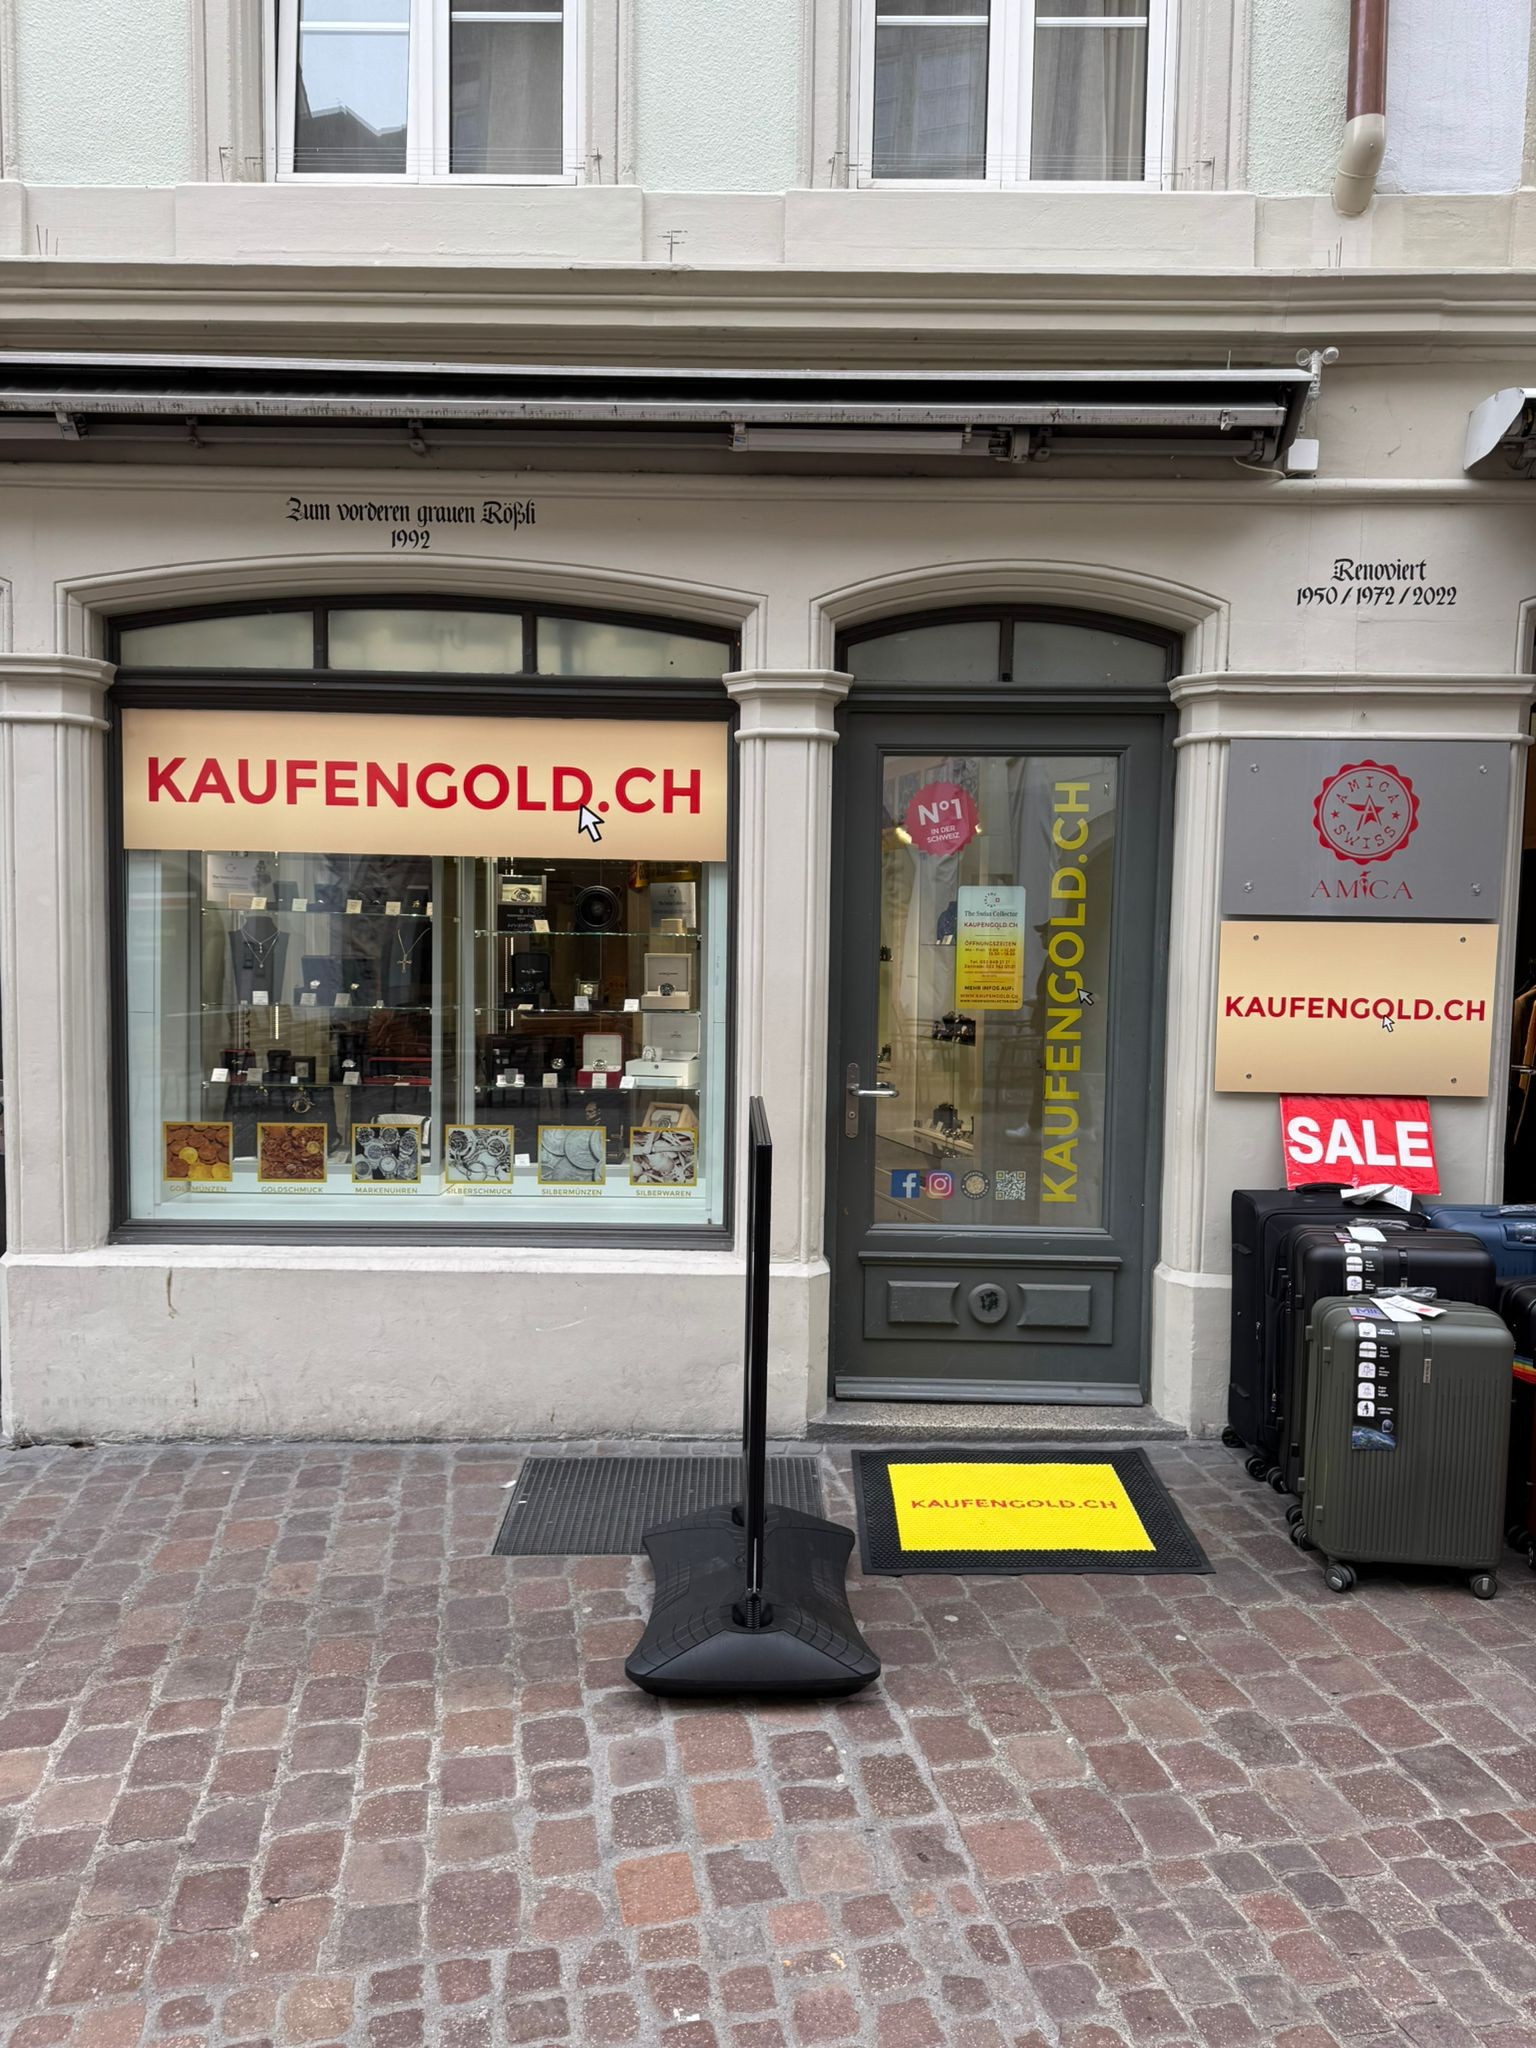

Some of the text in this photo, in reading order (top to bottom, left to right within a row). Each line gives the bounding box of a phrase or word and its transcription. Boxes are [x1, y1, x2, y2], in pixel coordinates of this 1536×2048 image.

[285, 497, 537, 531] Zum vorderen grauen Rößli
[391, 529, 431, 549] 1992
[1331, 558, 1428, 582] Renoviert
[148, 757, 702, 815] KAUFENGOLD.CH
[1335, 776, 1400, 804] AMICA
[927, 832, 961, 843] SCHWEIZ
[931, 825, 956, 835] IN DER
[1333, 823, 1397, 850] SWISS
[1041, 782, 1091, 1203] KAUFENGOLD.CH
[1225, 996, 1486, 1022] KAUFENGOLD.CH
[1287, 1116, 1433, 1168] SALE
[260, 1186, 324, 1194] GOLDSCHMUCK
[541, 1187, 603, 1196] SILBERMÜNZEN
[911, 1499, 1118, 1509] KAUFENGOLD.CH
